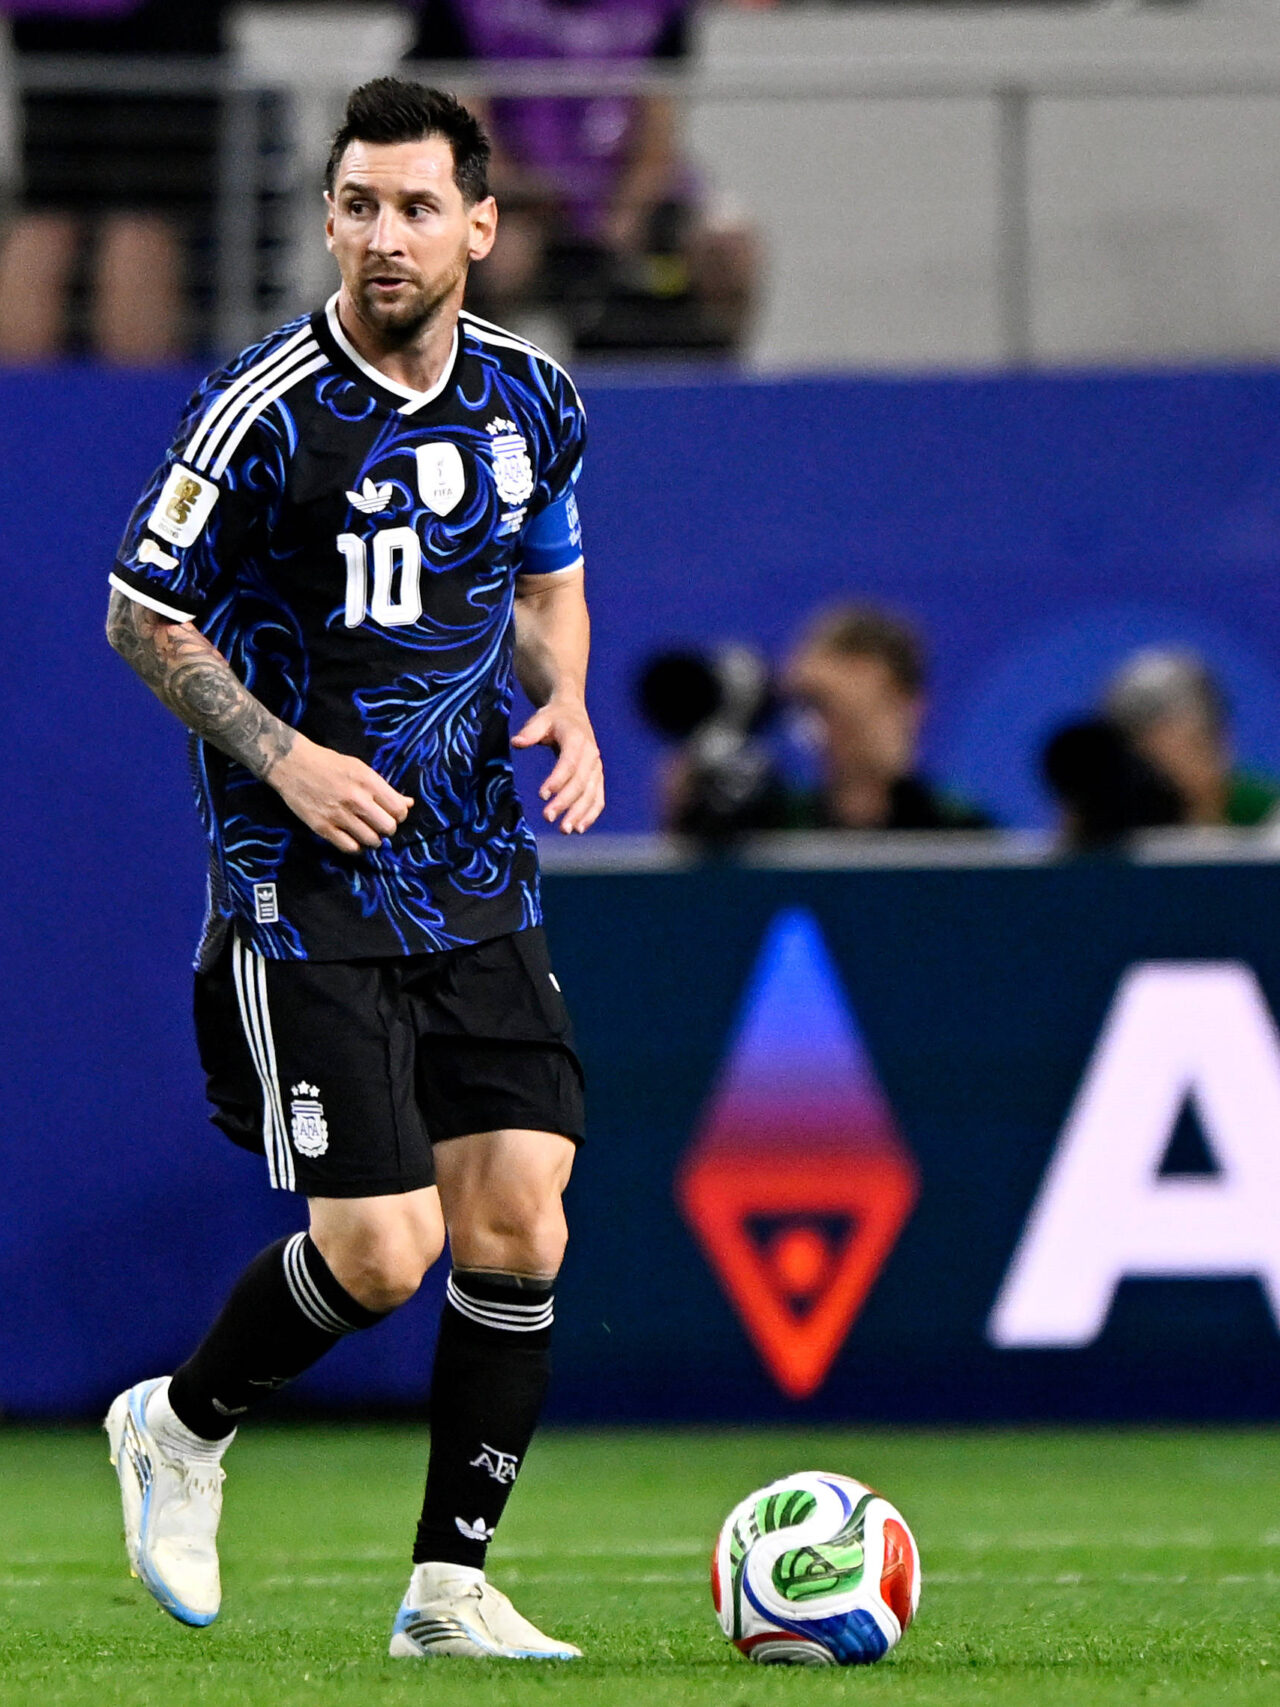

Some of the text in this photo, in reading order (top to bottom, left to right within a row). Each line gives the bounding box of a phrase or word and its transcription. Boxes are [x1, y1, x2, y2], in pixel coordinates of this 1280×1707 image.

[336, 526, 423, 629] 10
[300, 1115, 321, 1141] AFA
[986, 958, 1280, 1350] A
[469, 1442, 518, 1484] AFA
